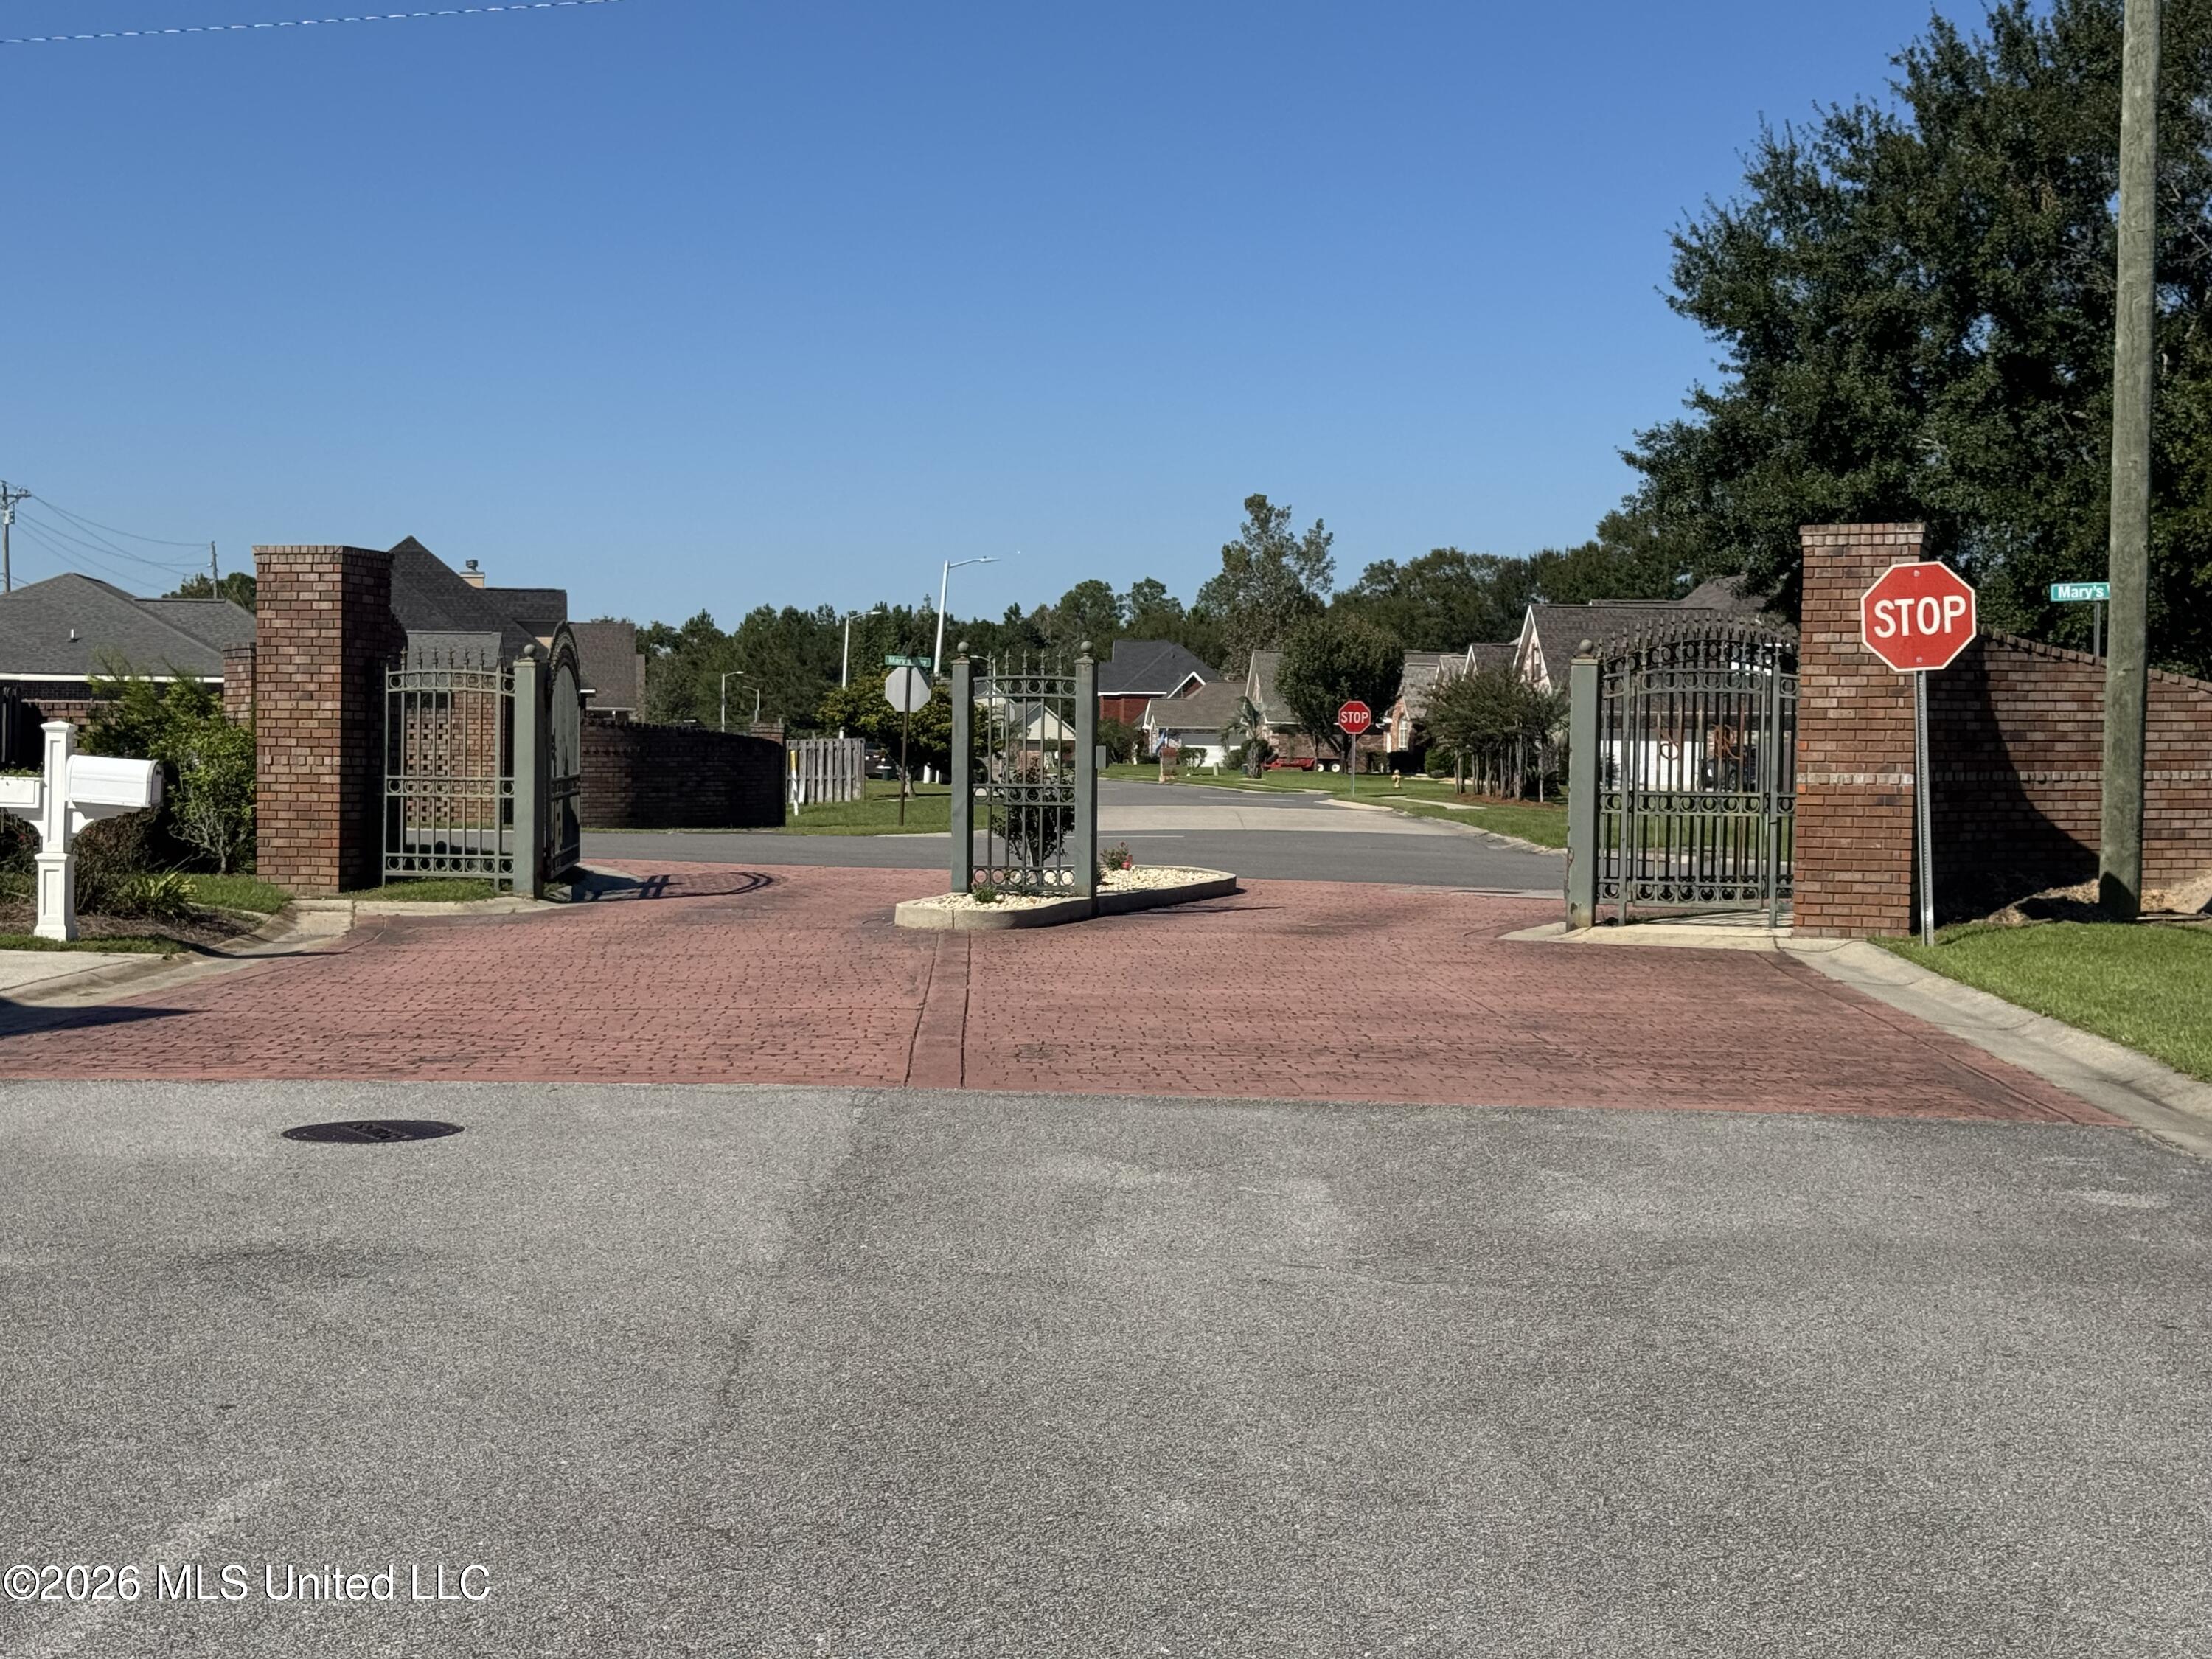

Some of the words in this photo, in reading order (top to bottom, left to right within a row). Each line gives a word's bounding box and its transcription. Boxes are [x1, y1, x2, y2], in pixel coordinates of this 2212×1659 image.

[2058, 585, 2104, 599] Mary's
[1874, 594, 1966, 639] STOP
[1340, 711, 1368, 724] STOP
